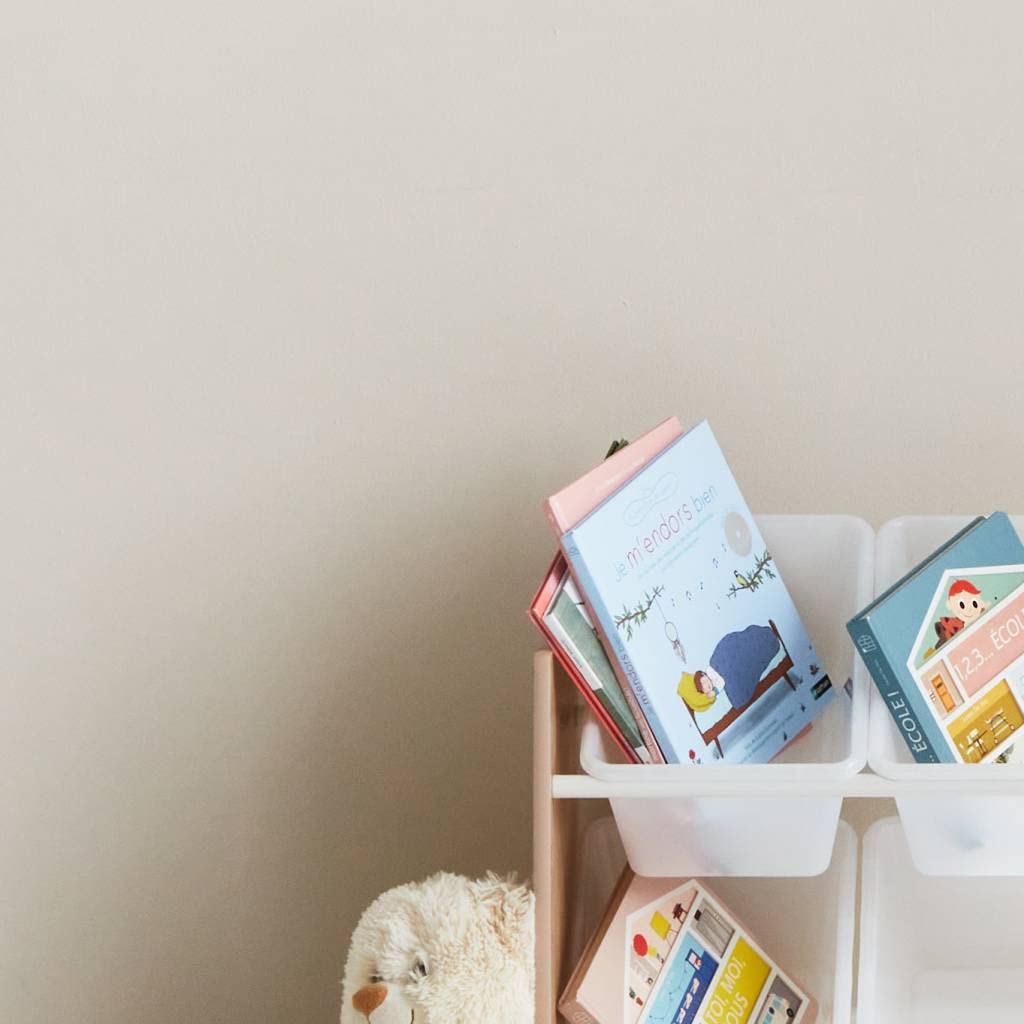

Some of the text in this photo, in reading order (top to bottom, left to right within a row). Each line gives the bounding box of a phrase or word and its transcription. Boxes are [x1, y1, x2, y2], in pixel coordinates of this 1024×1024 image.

[626, 503, 692, 568] m'endors
[693, 485, 717, 511] bien
[891, 698, 927, 753] ÉCOLE
